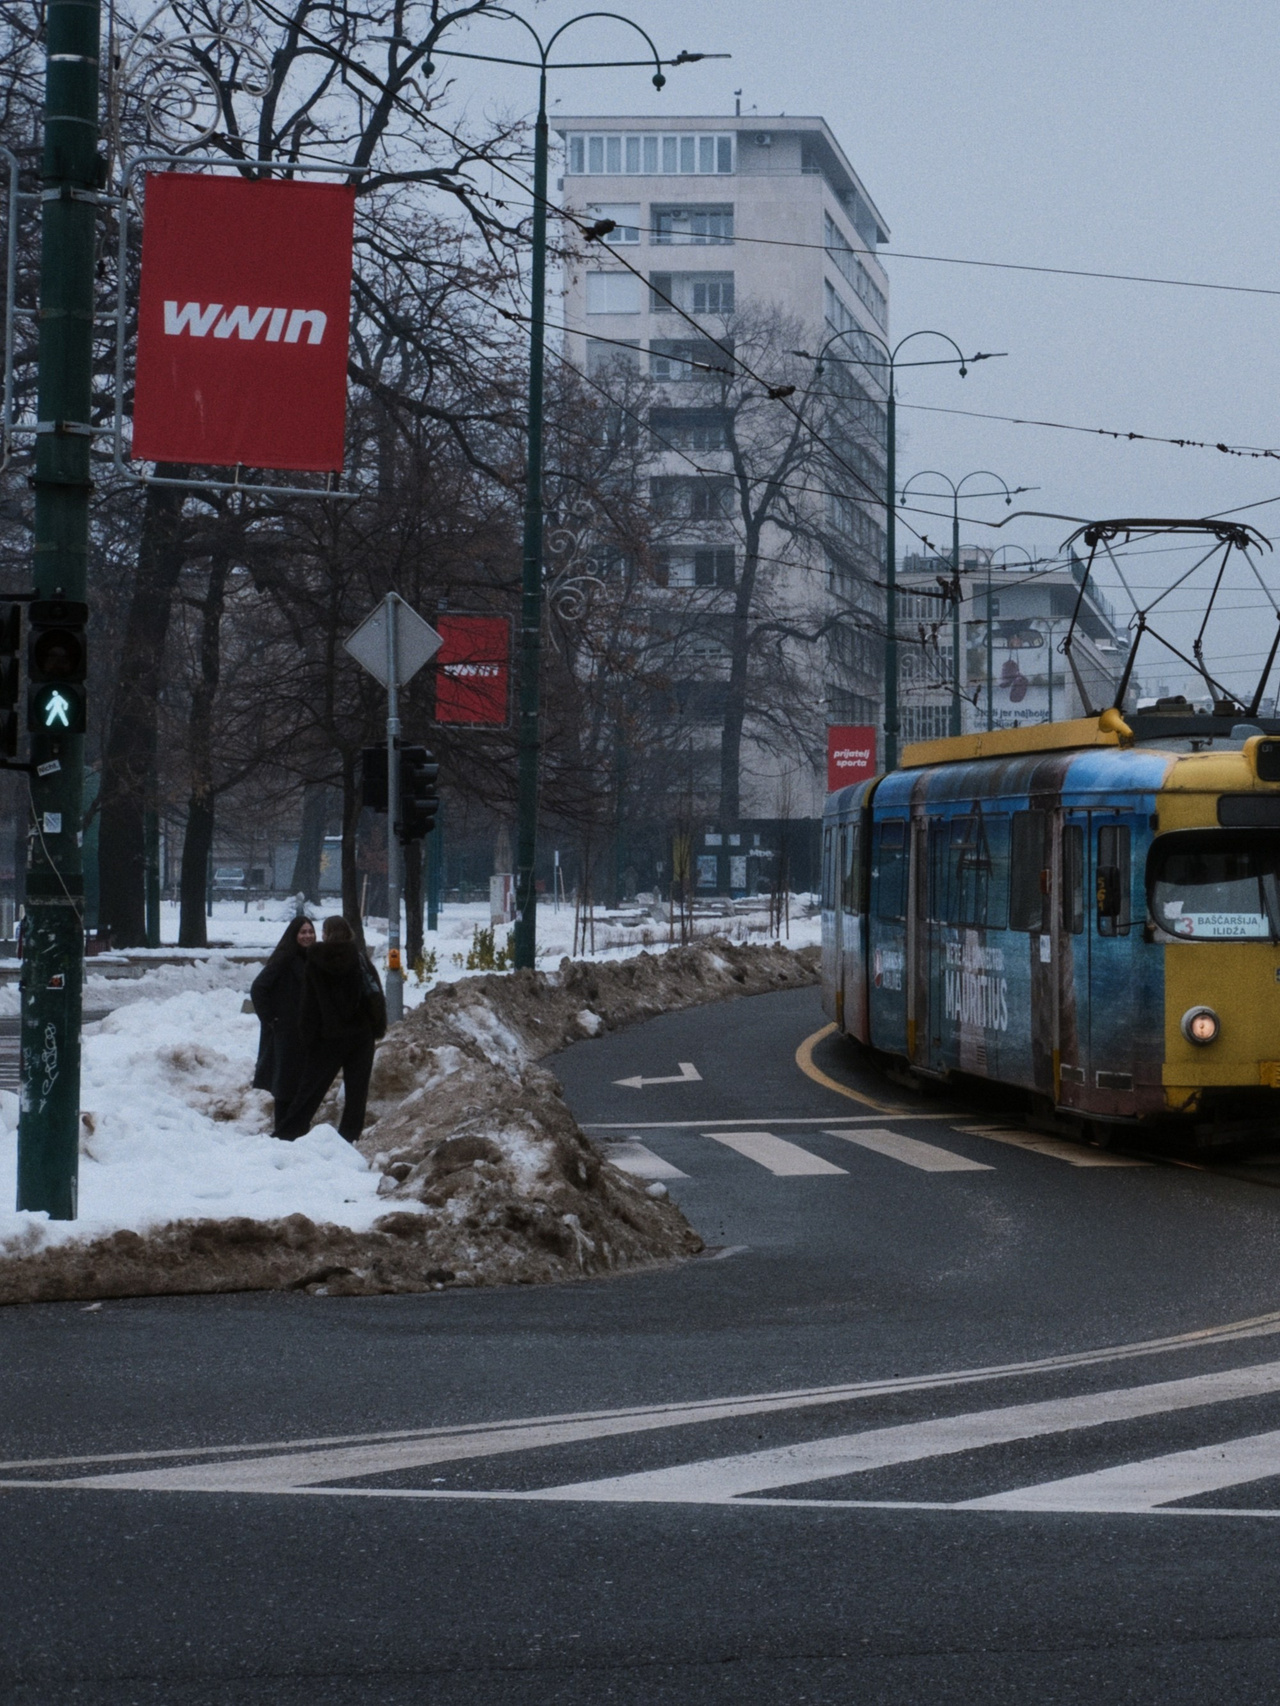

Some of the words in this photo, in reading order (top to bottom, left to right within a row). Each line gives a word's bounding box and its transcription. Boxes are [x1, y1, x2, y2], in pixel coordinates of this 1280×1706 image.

[164, 300, 328, 346] wwin
[833, 749, 870, 760] prijatelj
[836, 759, 867, 769] sporta
[1179, 917, 1194, 935] 3
[1197, 915, 1258, 926] BAŠČARŠIJA
[1213, 926, 1246, 936] ILIDŽA
